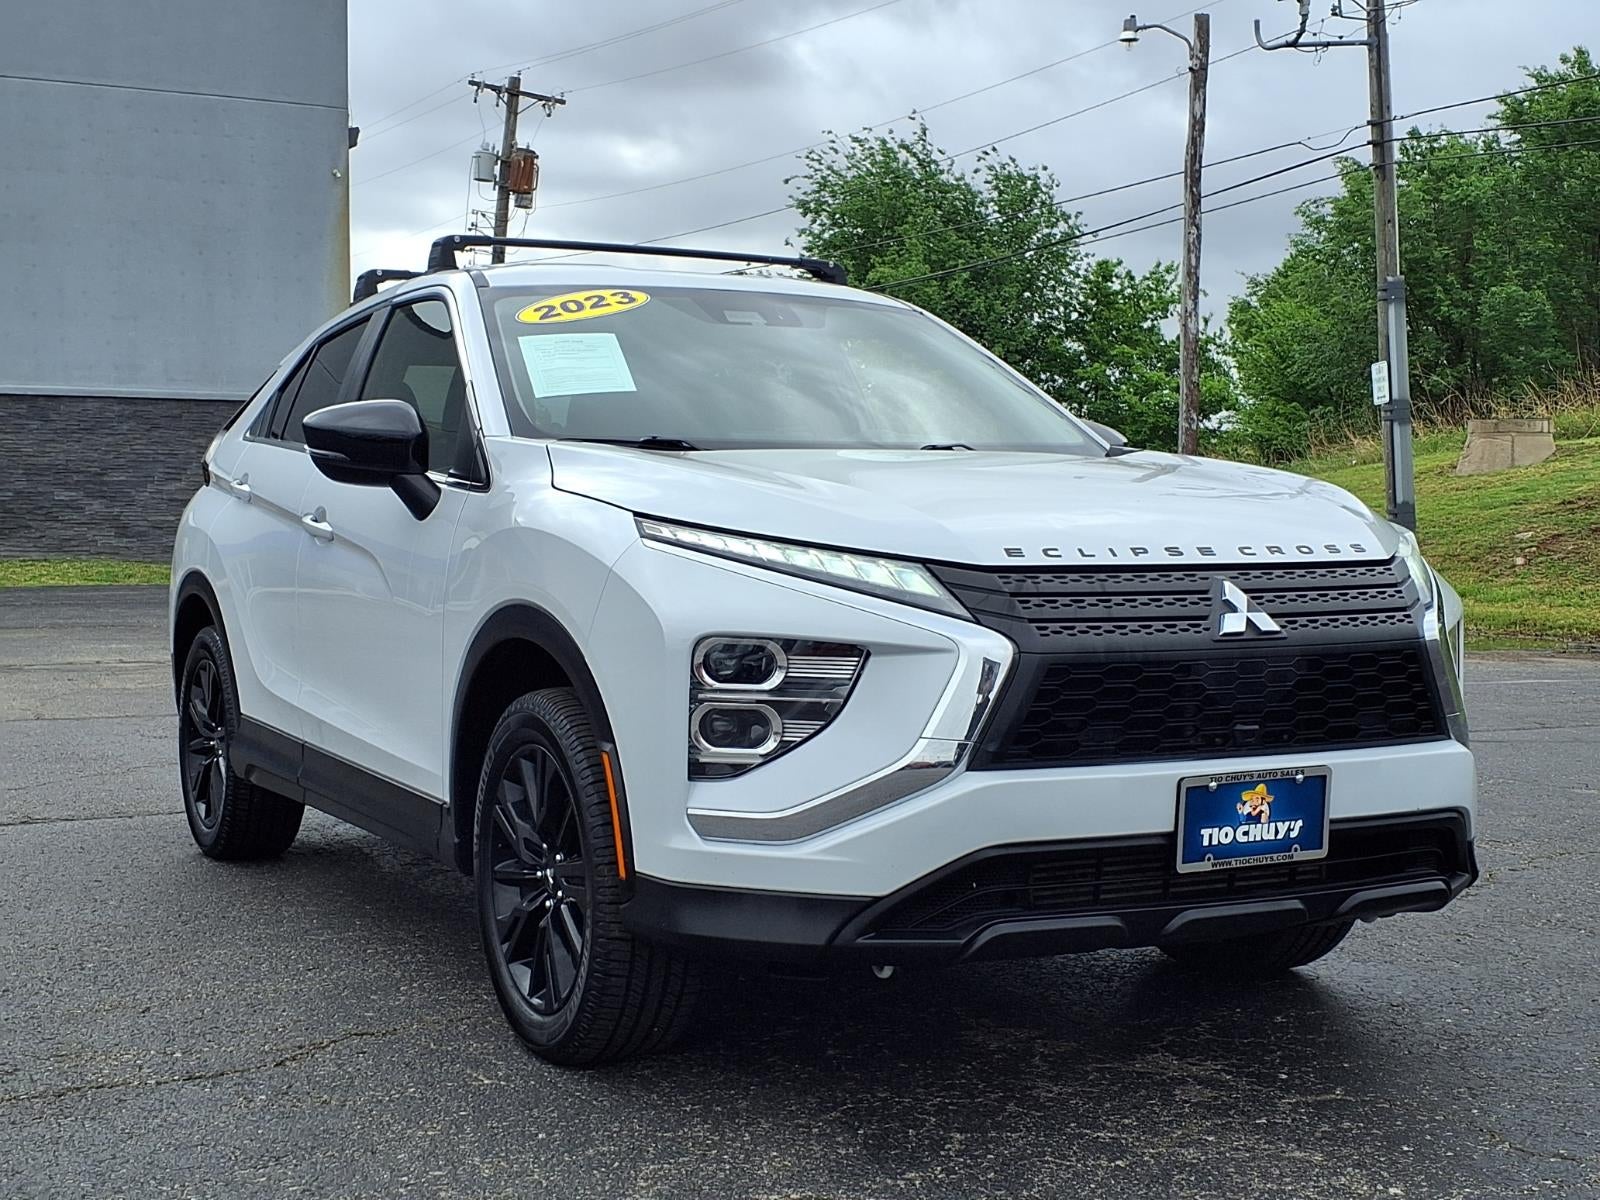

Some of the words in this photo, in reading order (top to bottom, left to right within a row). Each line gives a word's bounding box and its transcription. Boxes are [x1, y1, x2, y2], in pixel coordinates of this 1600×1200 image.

[533, 291, 637, 321] 2023
[1003, 546, 1217, 558] ECLIPSE
[1237, 543, 1367, 556] CROSS
[1225, 773, 1255, 782] CHUY'S
[1256, 771, 1278, 779] AUTO
[1280, 769, 1305, 777] SALES
[1211, 853, 1294, 869] WWW.TIOCHUYS.COM
